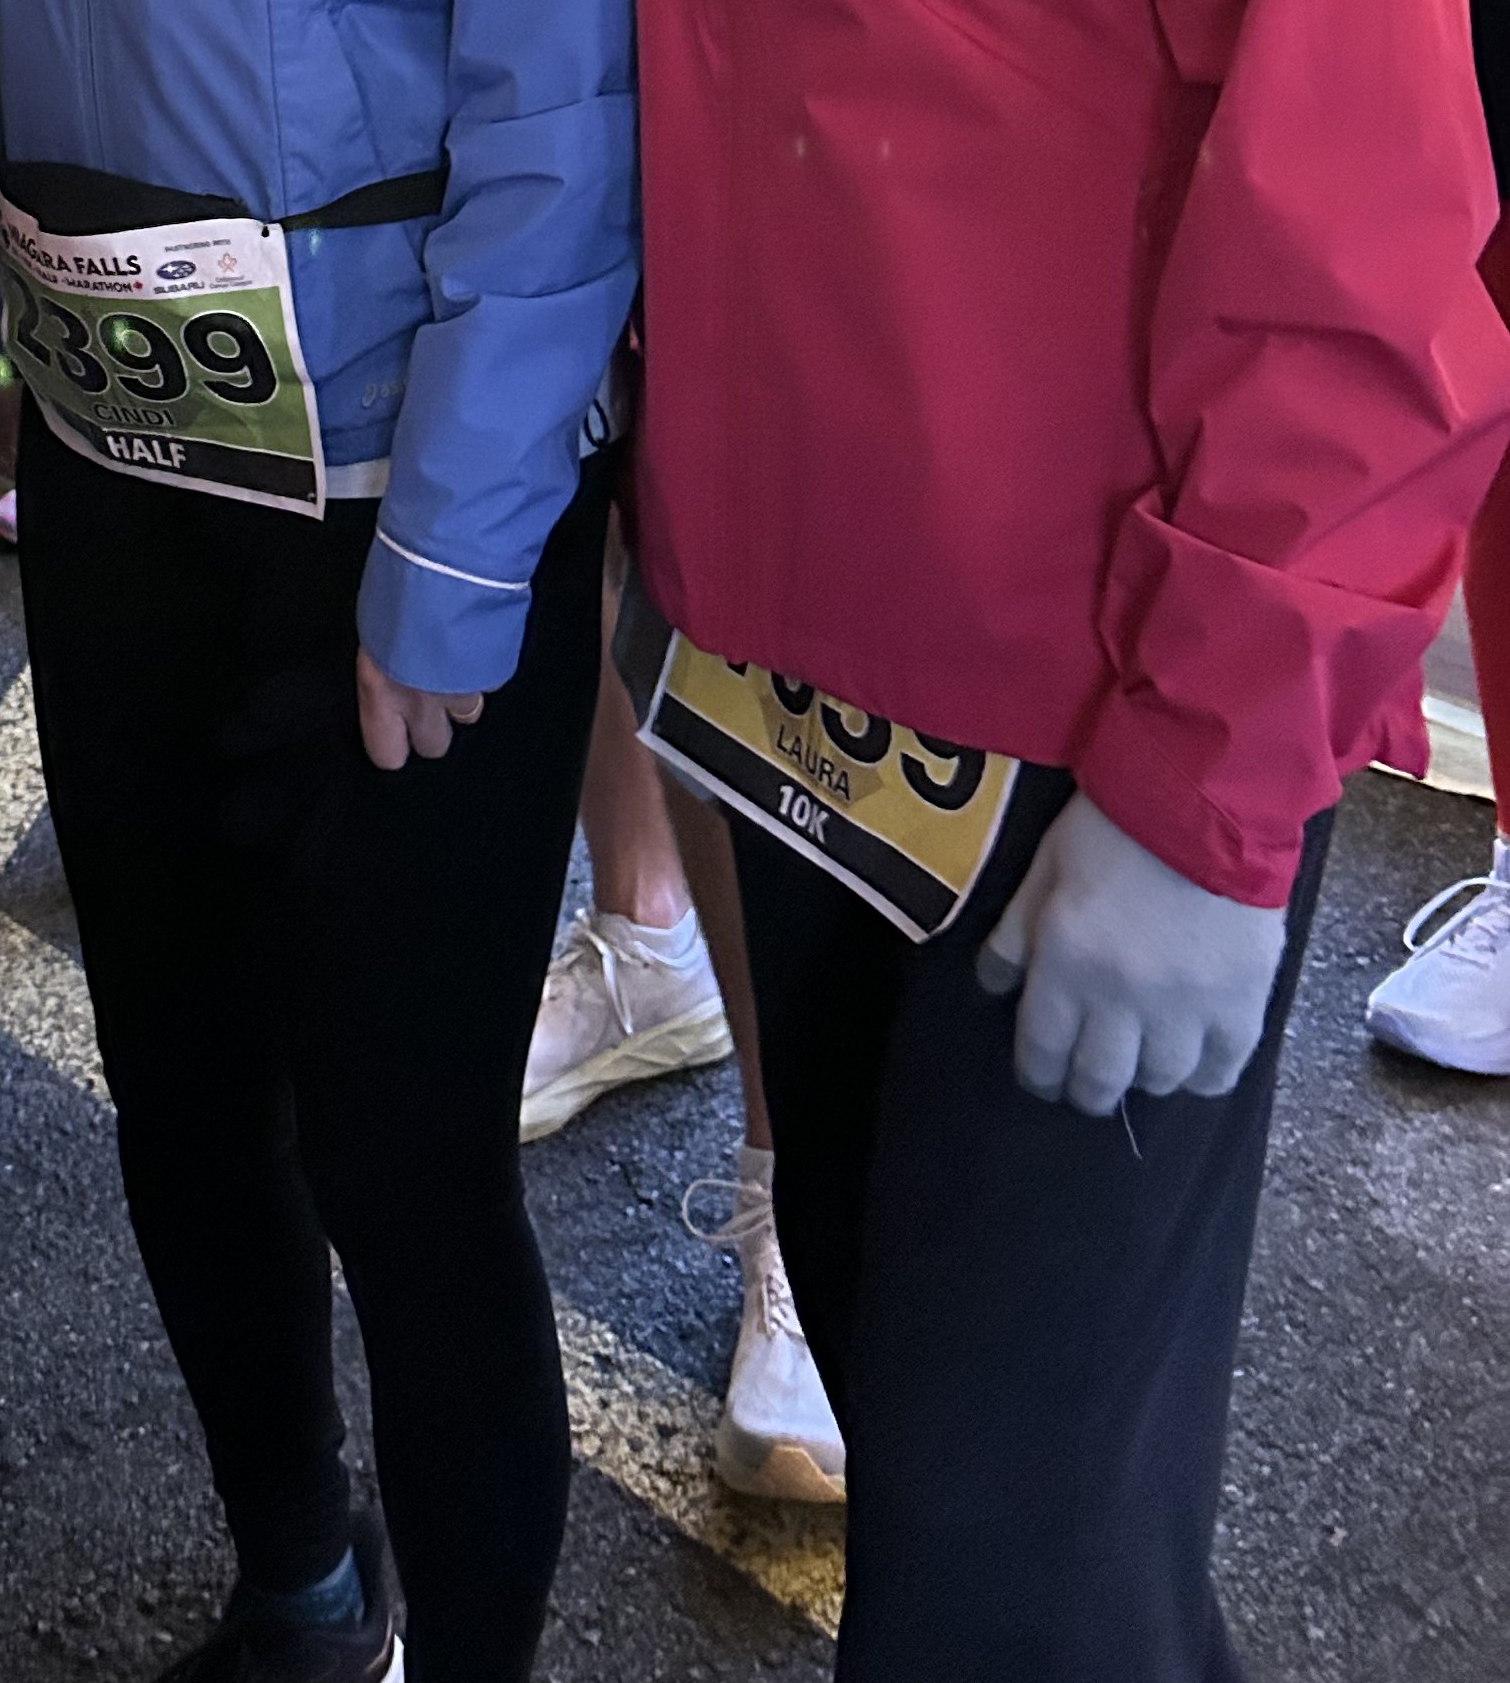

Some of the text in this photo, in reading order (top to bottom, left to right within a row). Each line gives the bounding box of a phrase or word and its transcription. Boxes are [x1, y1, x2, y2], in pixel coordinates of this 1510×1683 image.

[73, 254, 142, 277] FALLS
[153, 281, 206, 295] SUBARU
[93, 403, 176, 428] CINDI
[106, 434, 187, 469] HALF
[775, 725, 852, 802] LAURA
[778, 784, 831, 845] 10K
